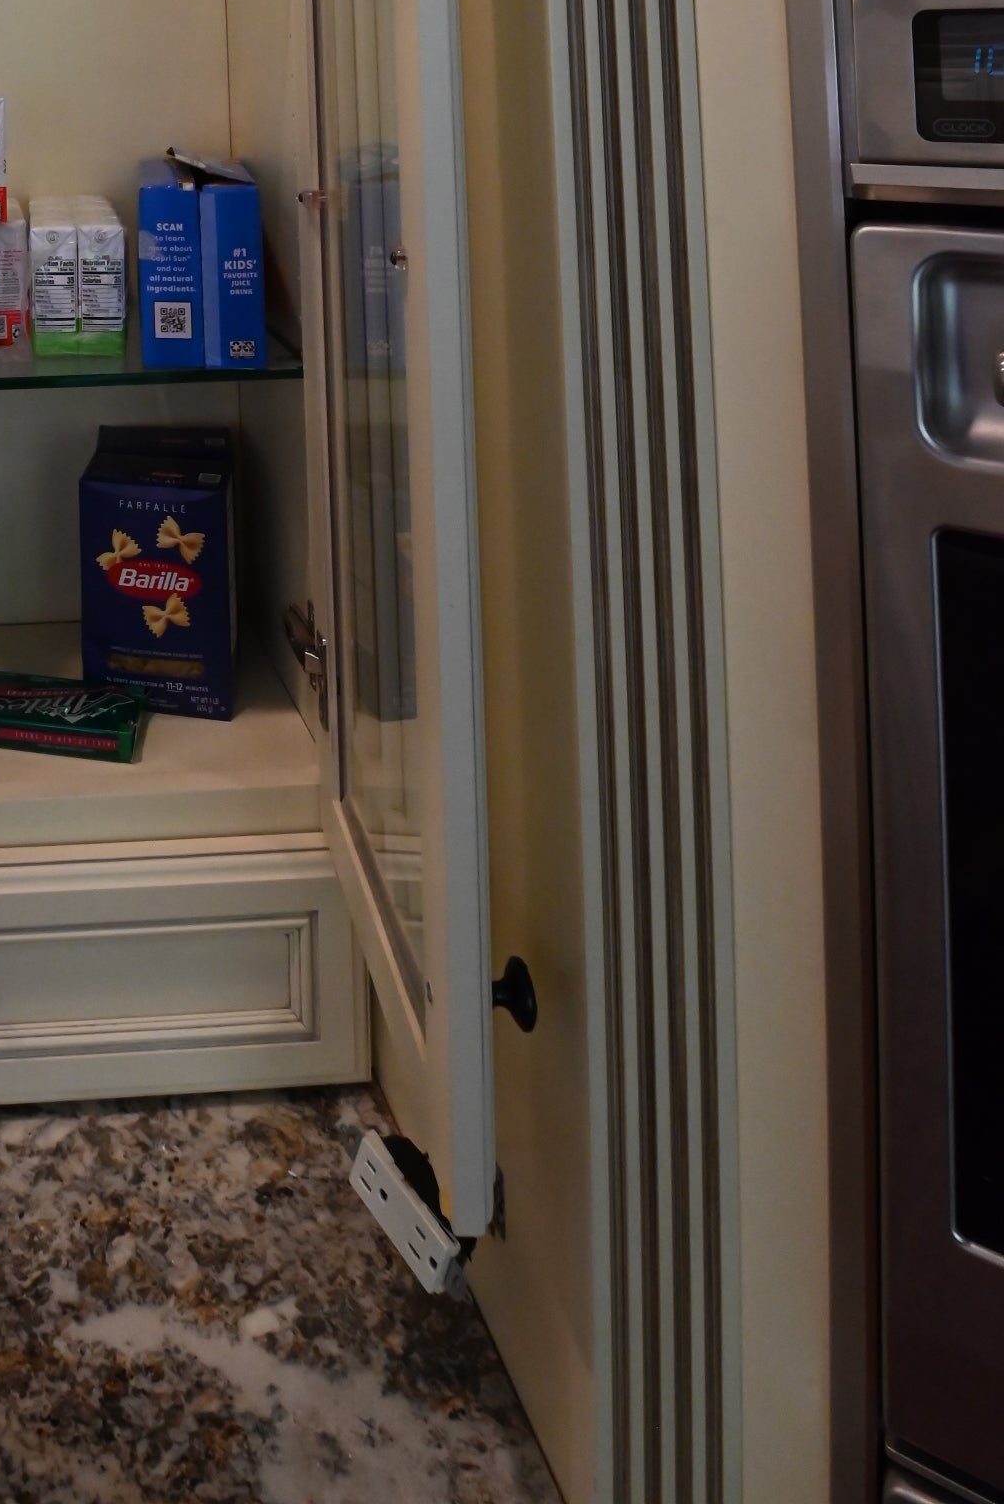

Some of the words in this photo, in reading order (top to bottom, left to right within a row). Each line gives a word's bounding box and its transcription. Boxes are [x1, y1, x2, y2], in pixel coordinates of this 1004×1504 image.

[940, 122, 986, 133] CLOCK
[156, 223, 183, 232] SCAN
[165, 234, 186, 242] learn
[233, 247, 247, 258] #1
[151, 254, 171, 263] Capri
[224, 259, 257, 271] KIDS'
[146, 285, 197, 294] ingredients.
[119, 499, 187, 514] FARFALLE
[118, 567, 190, 592] Barilla
[165, 681, 184, 692] 11-12
